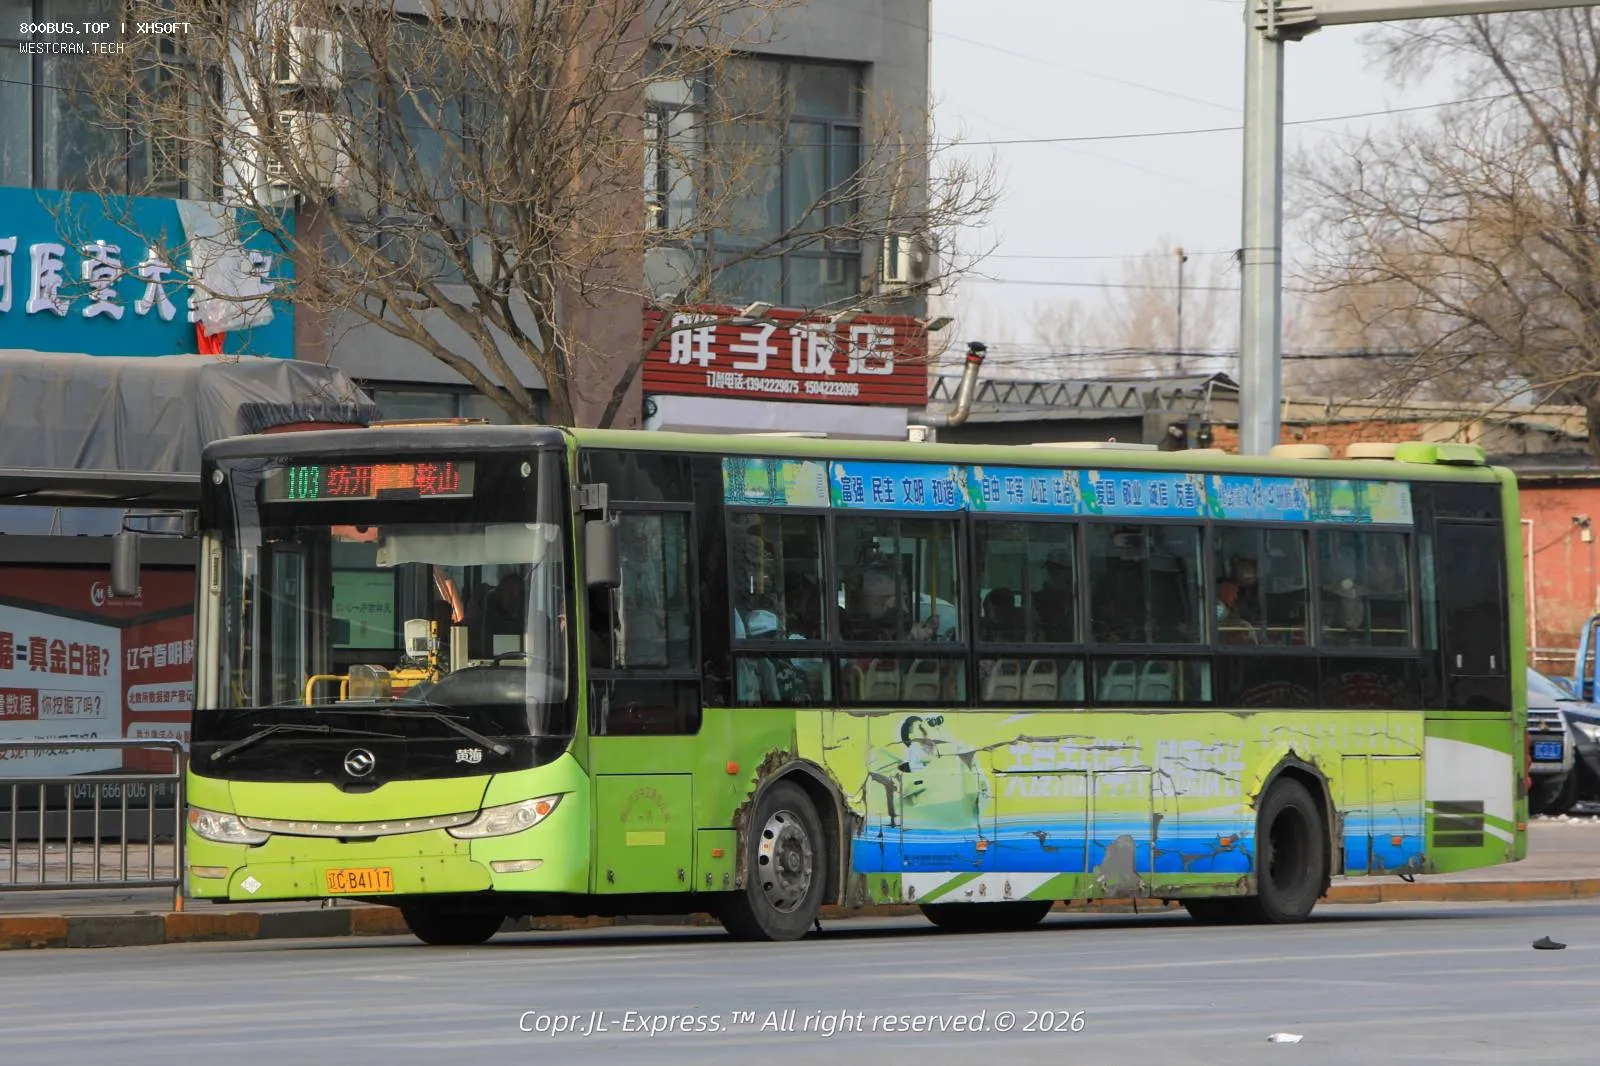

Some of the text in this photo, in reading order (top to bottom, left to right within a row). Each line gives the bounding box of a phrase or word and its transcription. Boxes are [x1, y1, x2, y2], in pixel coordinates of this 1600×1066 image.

[669, 312, 895, 375] 胖子饭店
[288, 466, 320, 499] 103
[840, 475, 864, 503] 富强
[872, 476, 896, 503] 民主
[902, 477, 925, 504] 文明
[982, 475, 1000, 502] 自由
[455, 748, 482, 764] 黄海
